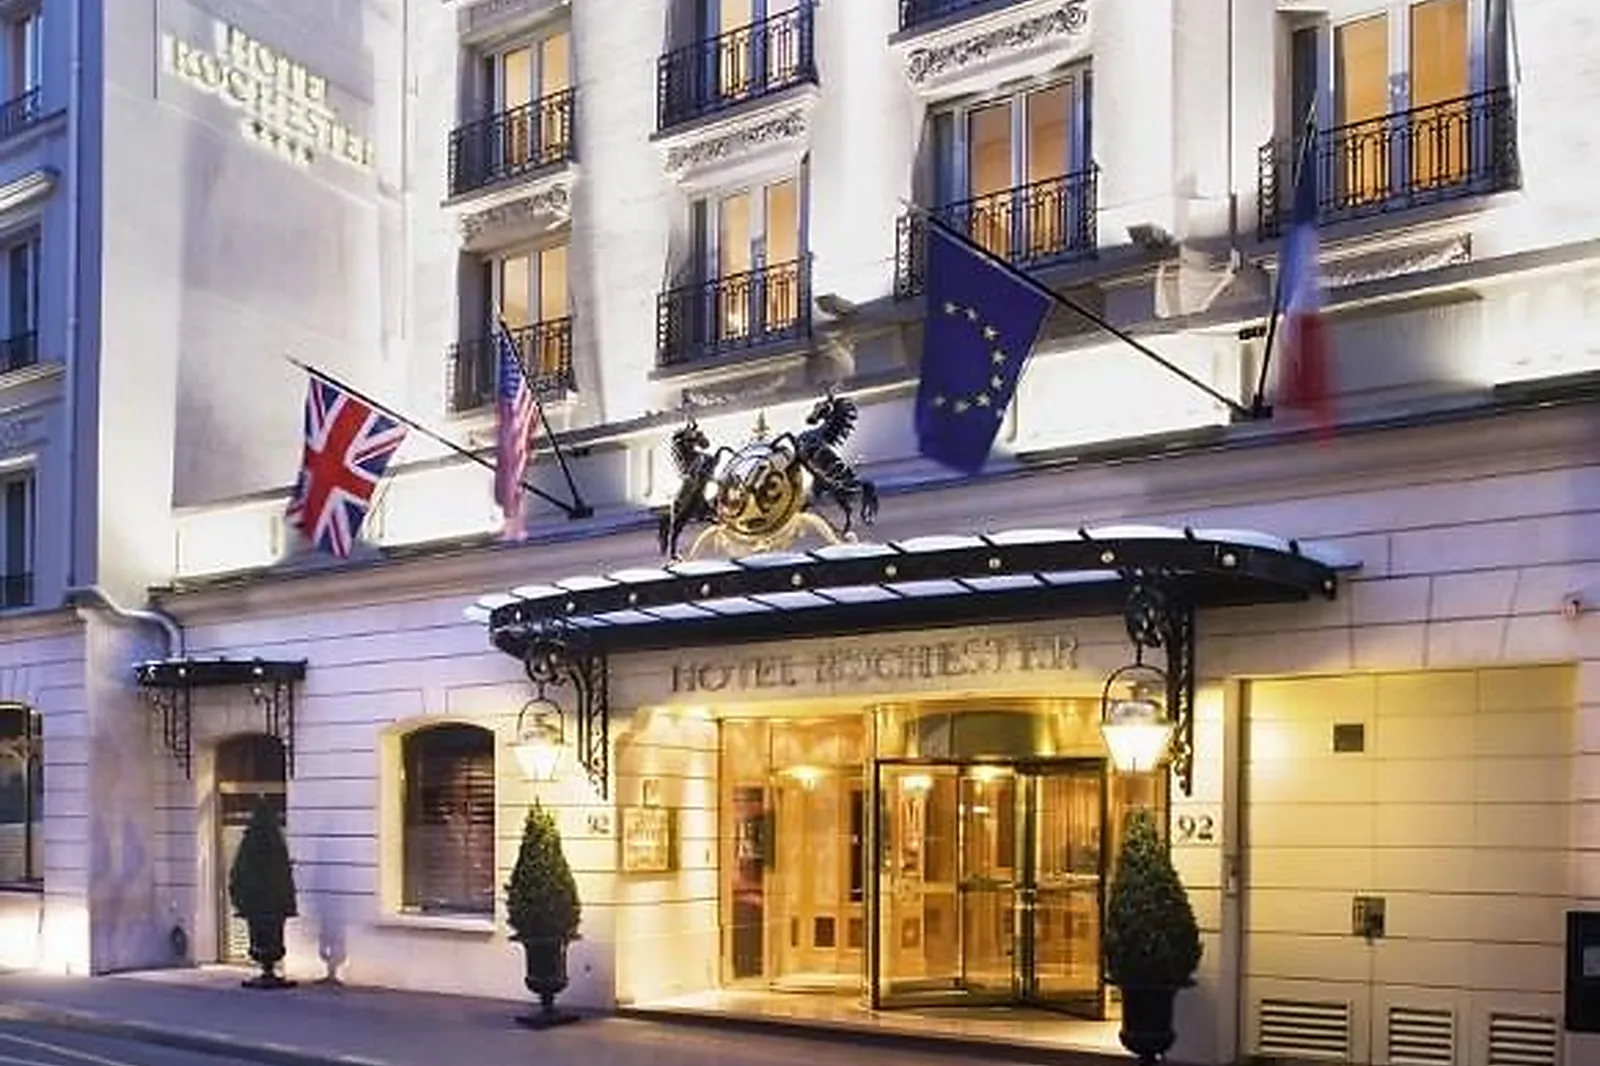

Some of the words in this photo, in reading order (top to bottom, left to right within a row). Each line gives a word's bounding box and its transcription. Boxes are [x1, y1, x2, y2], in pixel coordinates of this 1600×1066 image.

[671, 657, 797, 693] HOTEL
[815, 628, 1080, 683] ROCHESTER
[586, 813, 611, 835] 92
[1178, 814, 1214, 842] 92
